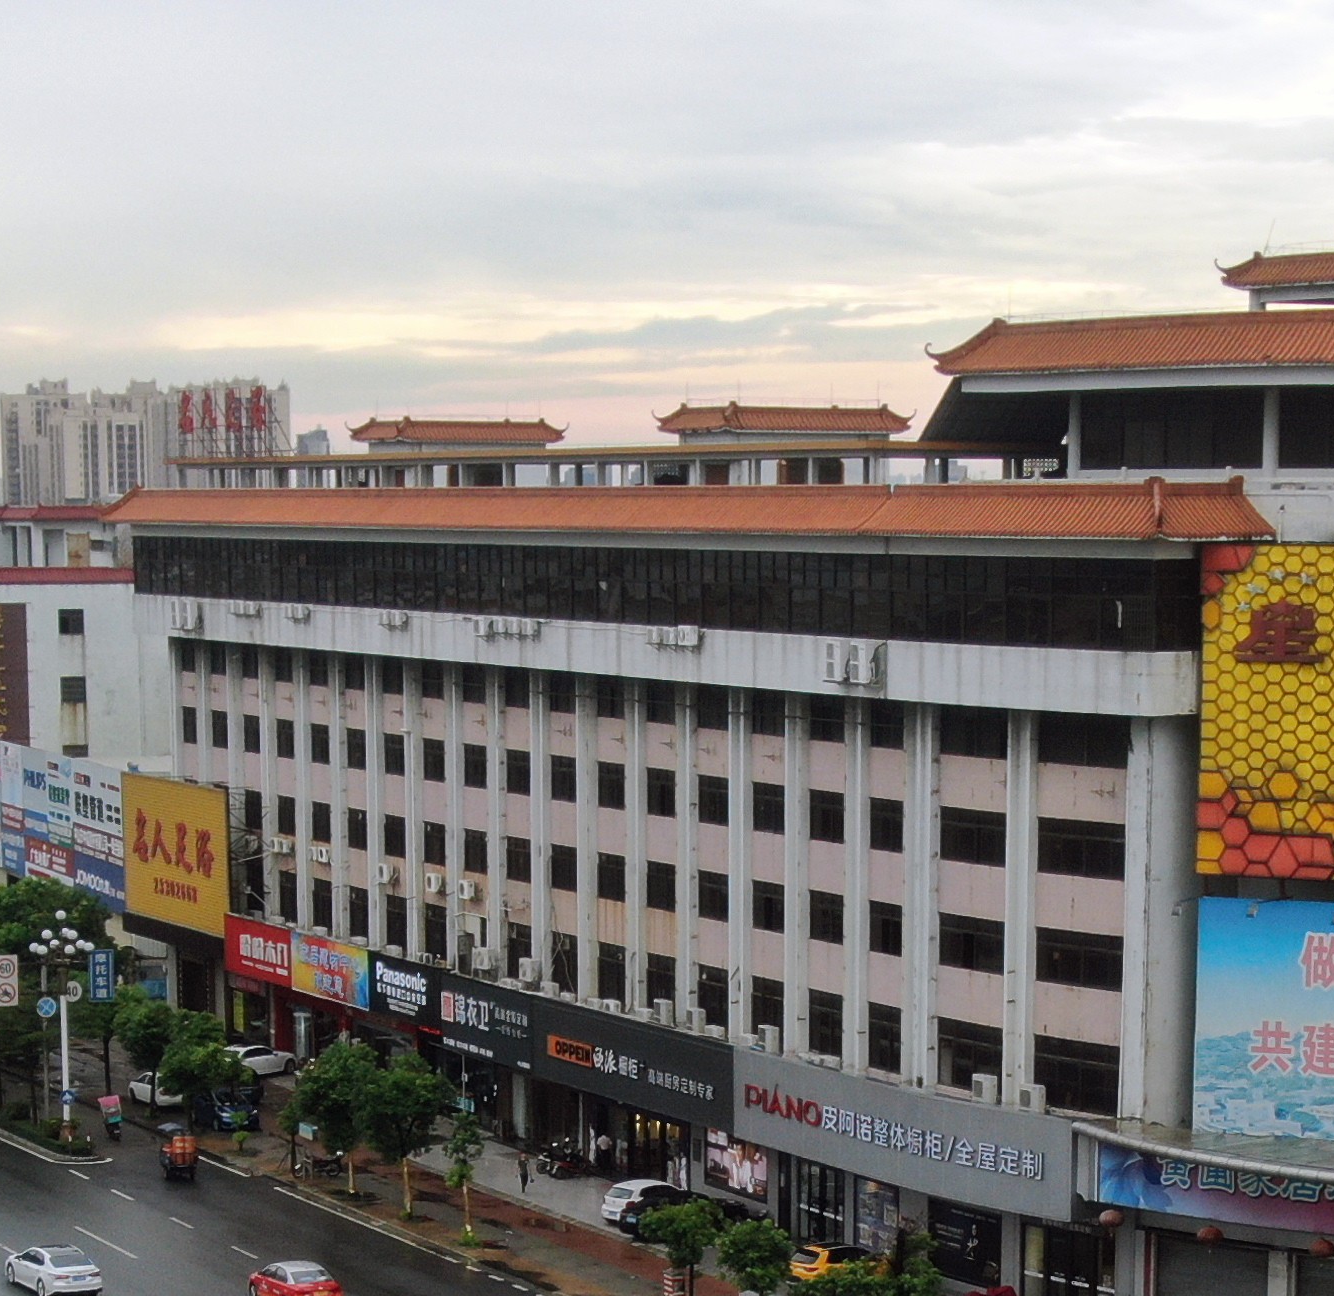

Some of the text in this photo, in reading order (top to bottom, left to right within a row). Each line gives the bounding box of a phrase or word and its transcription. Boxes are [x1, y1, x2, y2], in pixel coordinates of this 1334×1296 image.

[0, 963, 11, 974] 60
[94, 953, 108, 999] 摩托车道
[375, 961, 427, 993] Panasonic
[554, 1039, 591, 1063] OPPEIN
[743, 1083, 1044, 1181] PIANO 皮阿诺整体橱柜/全屋定制
